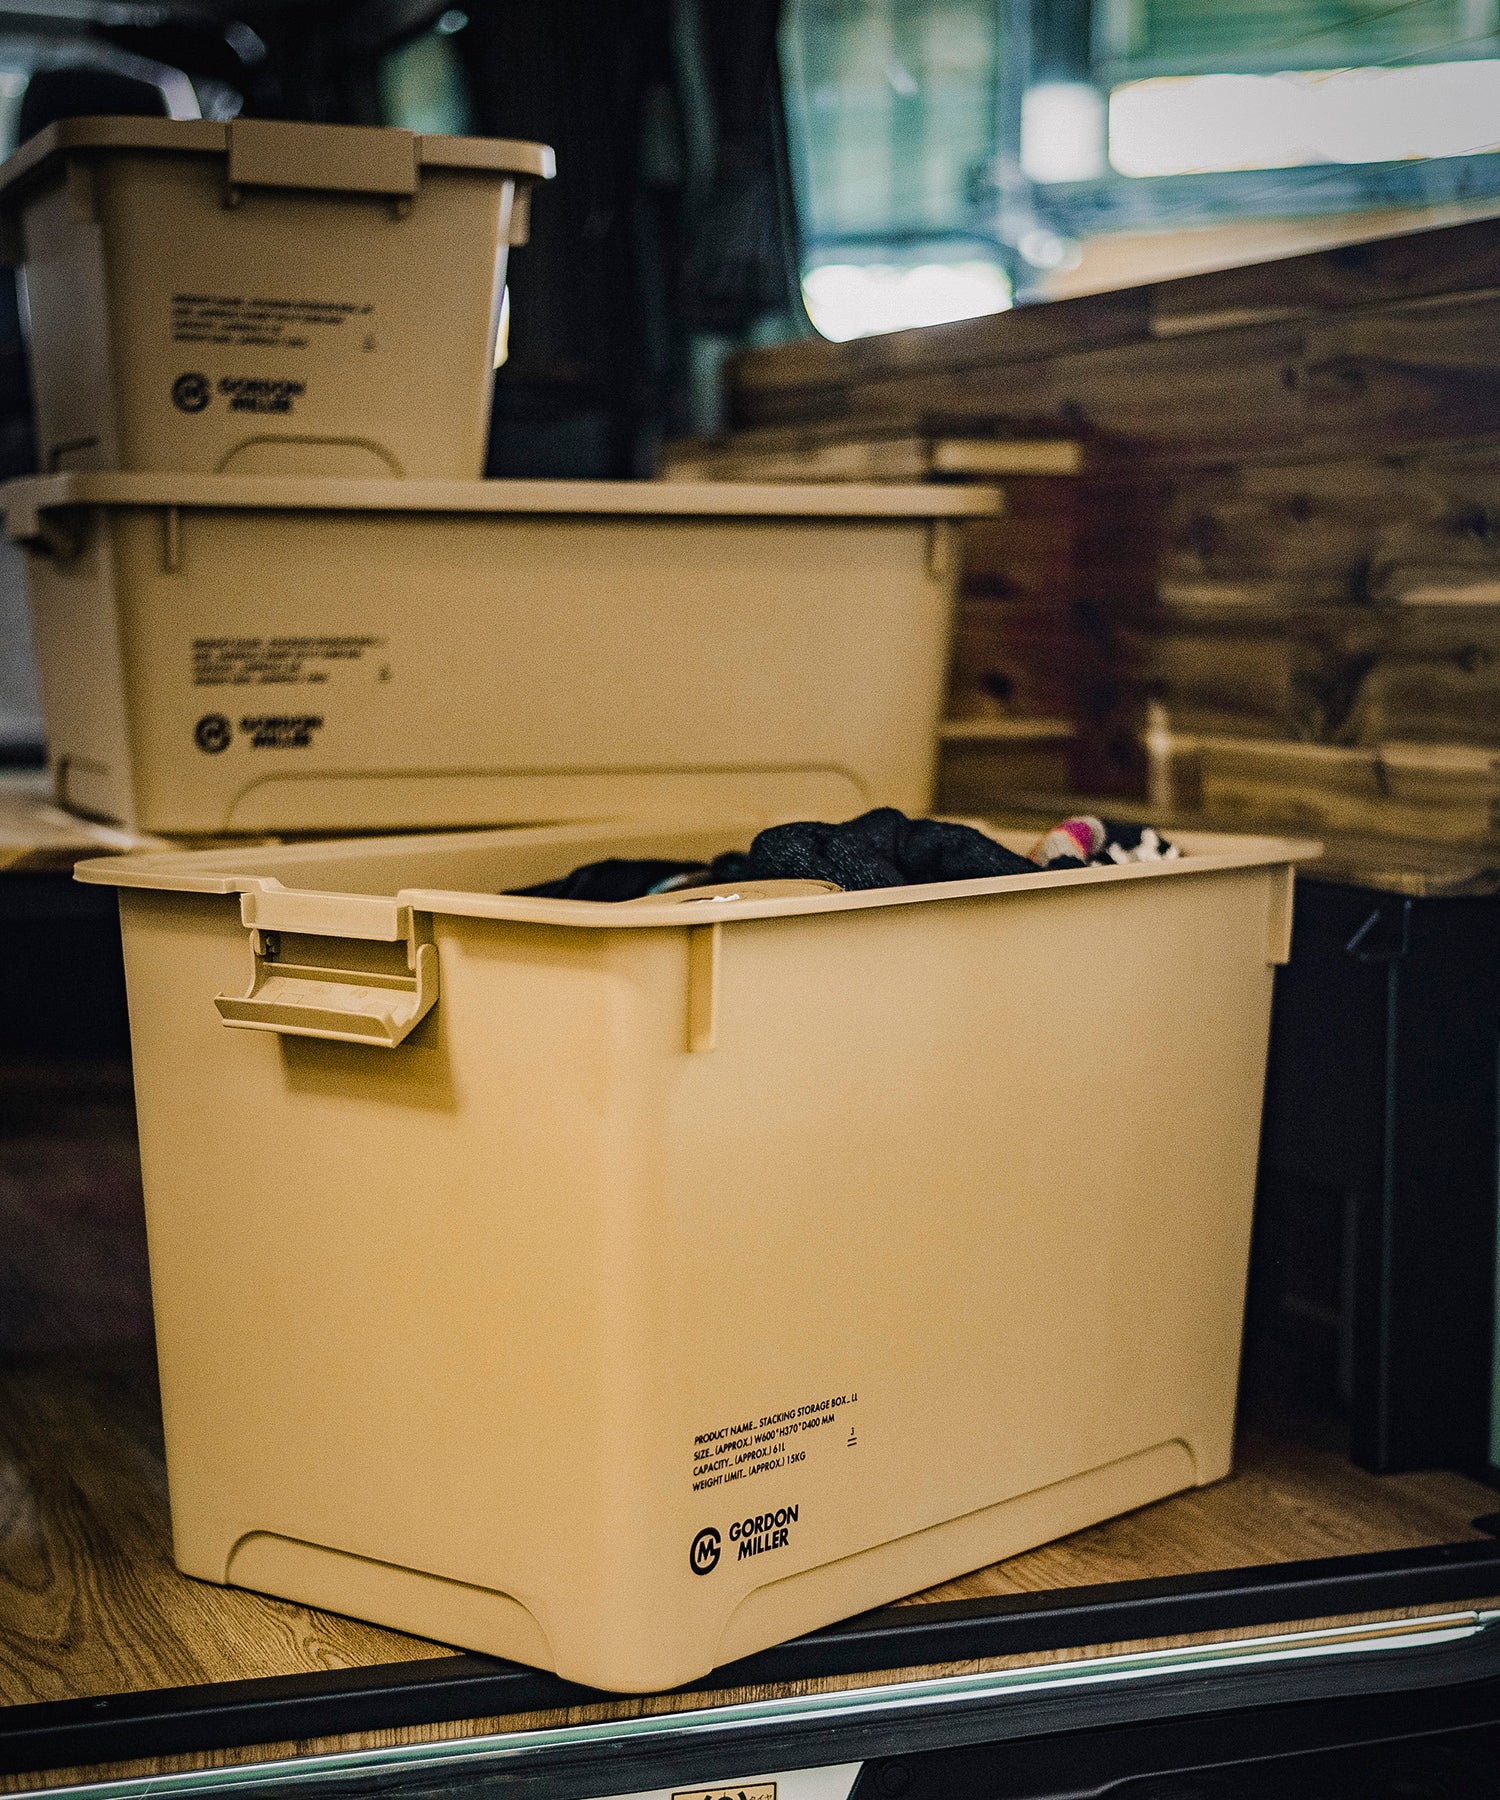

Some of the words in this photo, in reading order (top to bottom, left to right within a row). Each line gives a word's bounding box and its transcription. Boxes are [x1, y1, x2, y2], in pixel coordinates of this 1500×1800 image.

[694, 1427, 729, 1445] PRODUCT
[759, 1409, 796, 1428] STACKING
[797, 1400, 831, 1417] STORAGE
[821, 1414, 836, 1426] MM
[773, 1442, 786, 1454] 61L
[692, 1474, 723, 1492] WEIGHT
[786, 1451, 807, 1465] 15KG
[729, 1504, 799, 1542] GORDON
[737, 1527, 790, 1561] MILLER
